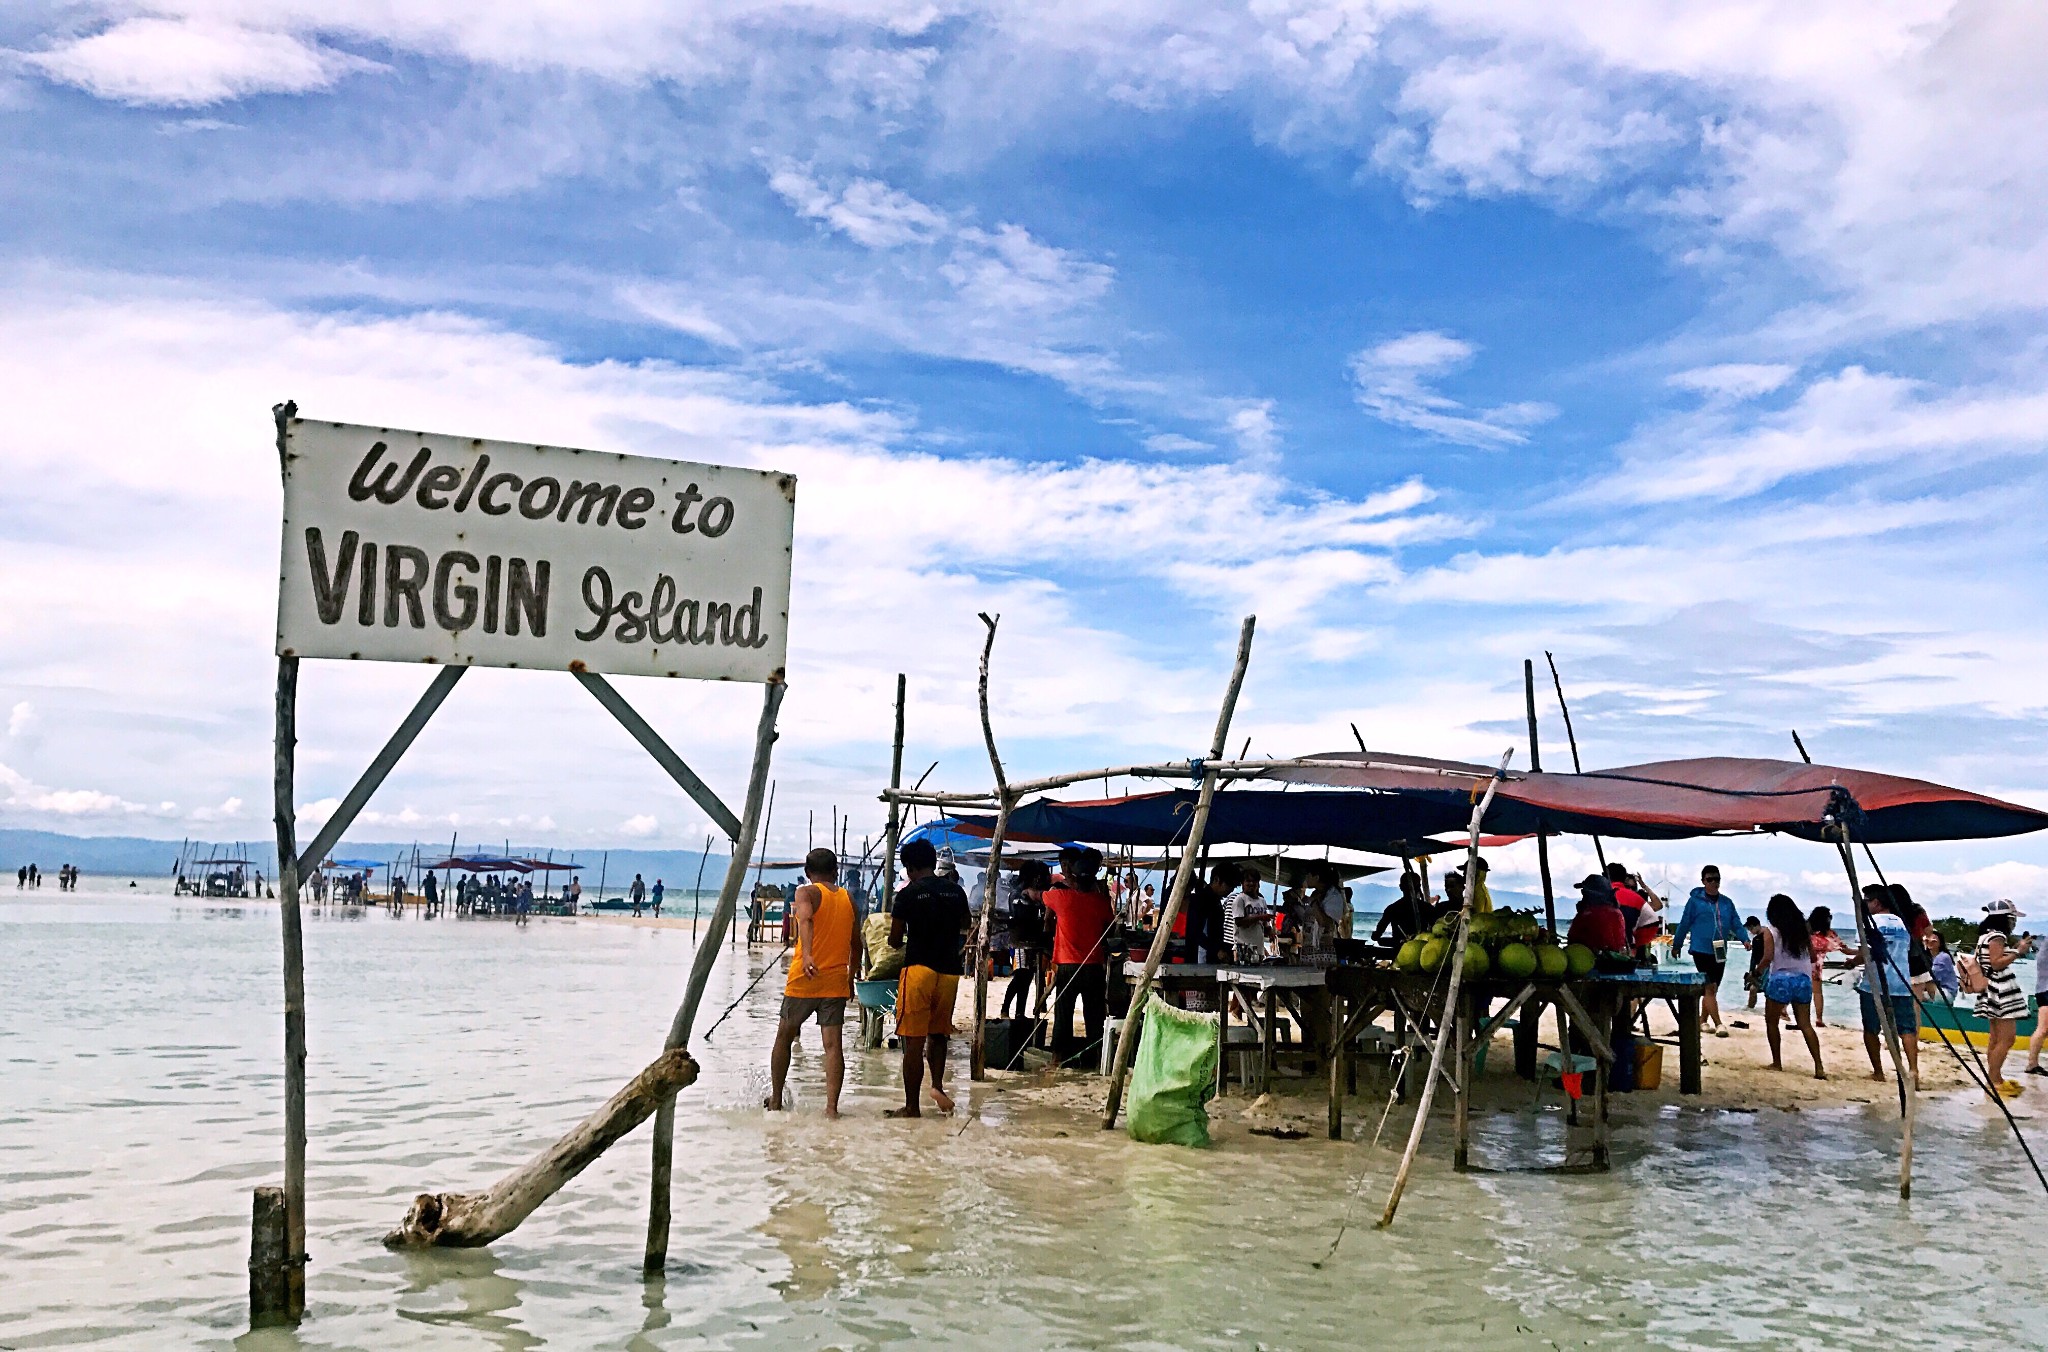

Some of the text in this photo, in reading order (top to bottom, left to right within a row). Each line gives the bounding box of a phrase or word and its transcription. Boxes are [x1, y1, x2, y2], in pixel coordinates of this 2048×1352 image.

[348, 441, 734, 538] Welcome to
[305, 527, 768, 648] VIRGIN Island
